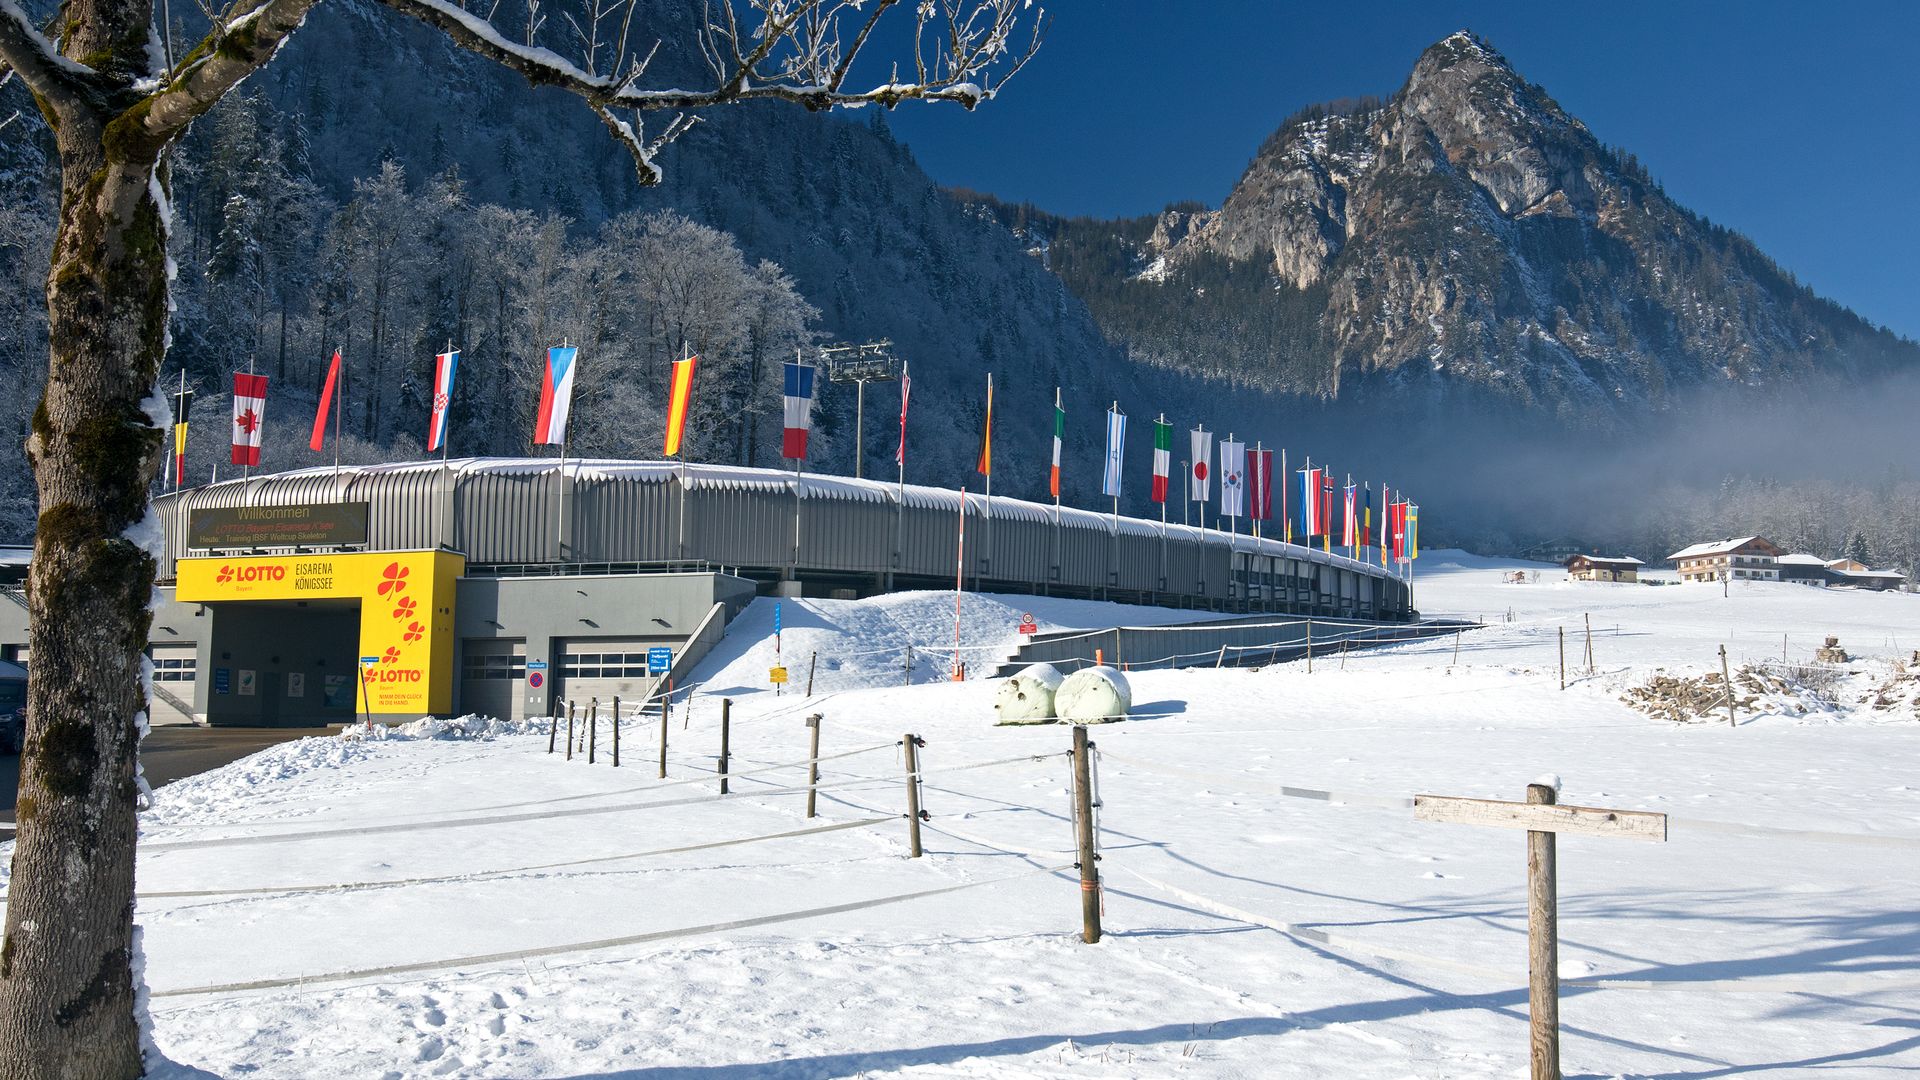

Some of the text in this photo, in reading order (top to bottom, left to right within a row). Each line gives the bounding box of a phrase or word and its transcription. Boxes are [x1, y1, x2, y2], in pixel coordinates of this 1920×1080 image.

[238, 507, 310, 520] Willkommen
[200, 535, 220, 543] Heute:
[226, 533, 251, 543] Training
[252, 533, 268, 542] IBSF
[297, 531, 327, 541] Skeleton
[237, 565, 286, 582] LOTTO
[295, 562, 333, 576] EISARENA
[294, 576, 333, 590] KÖNIGSSEE
[380, 669, 421, 682] LOTTO
